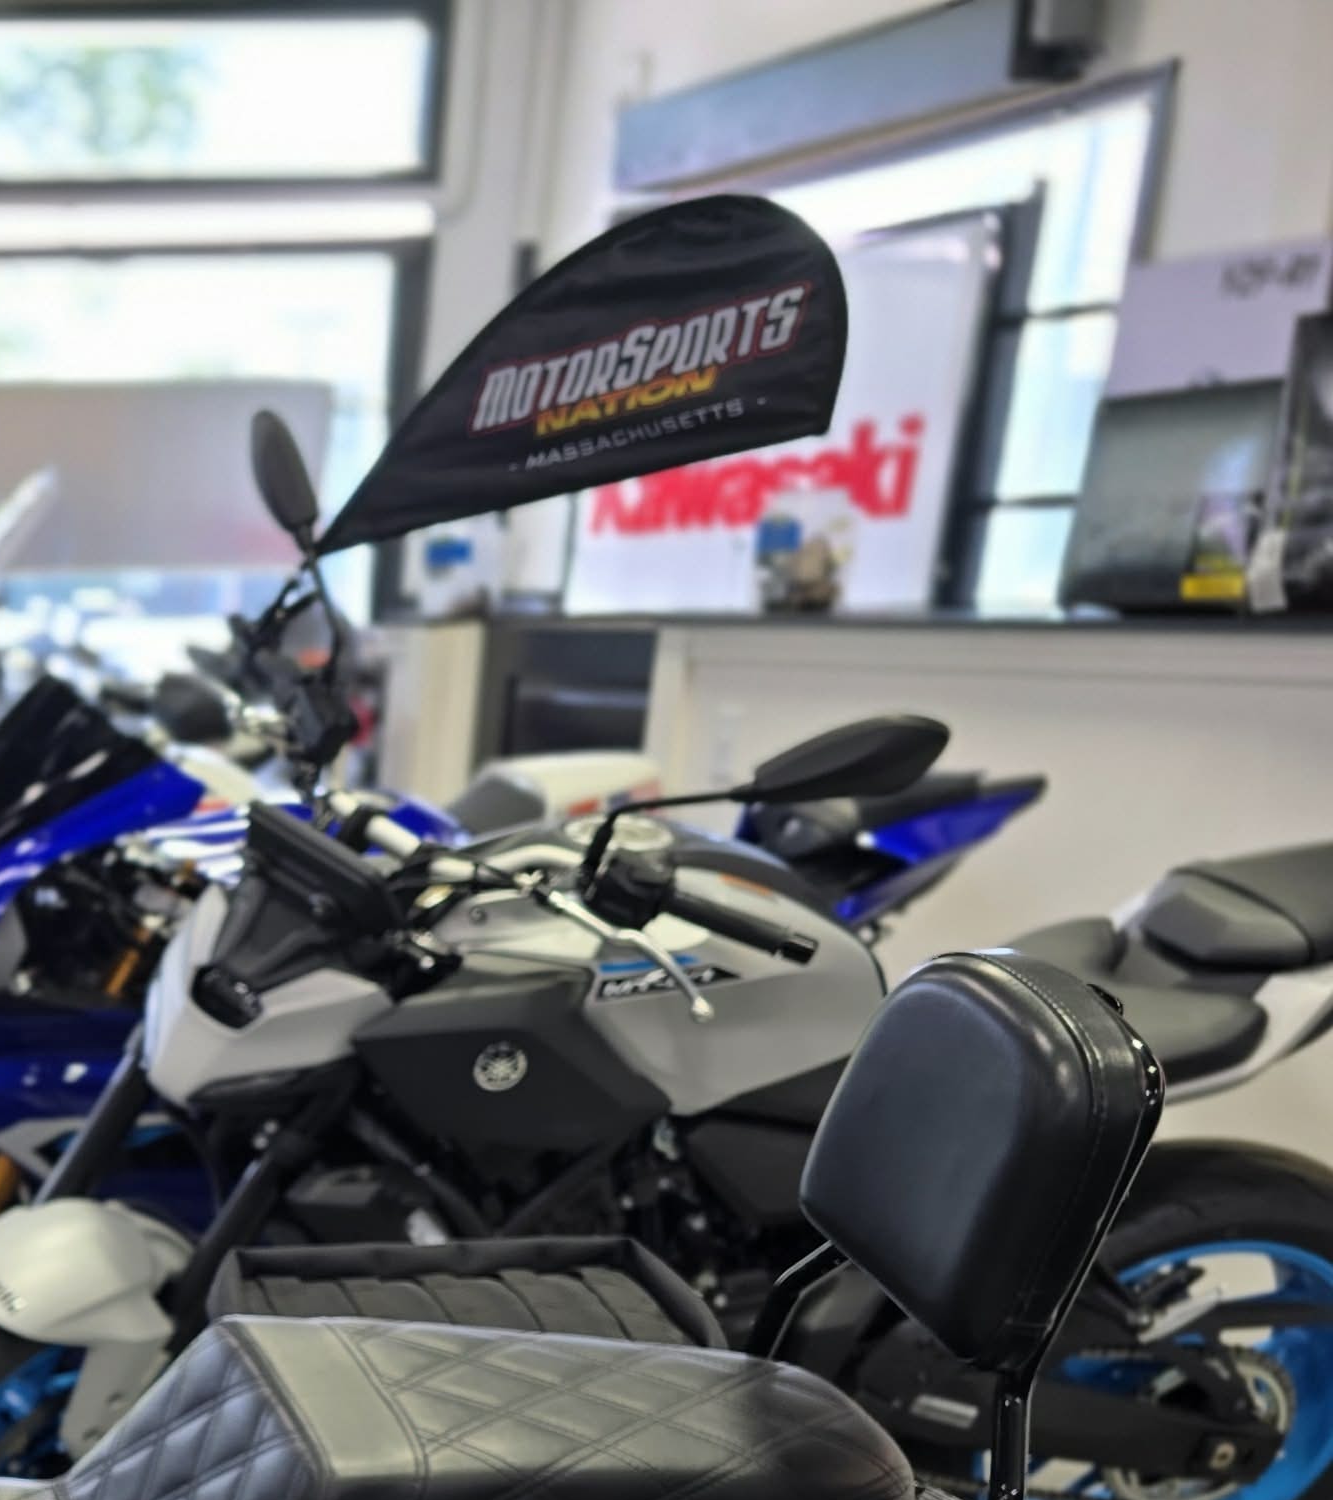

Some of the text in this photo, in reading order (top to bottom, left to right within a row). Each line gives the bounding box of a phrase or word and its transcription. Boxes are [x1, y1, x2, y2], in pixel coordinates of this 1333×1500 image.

[471, 283, 806, 434] MOTORSPORTS
[524, 397, 745, 470] MASSACHUSETTS
[535, 365, 719, 437] NATION
